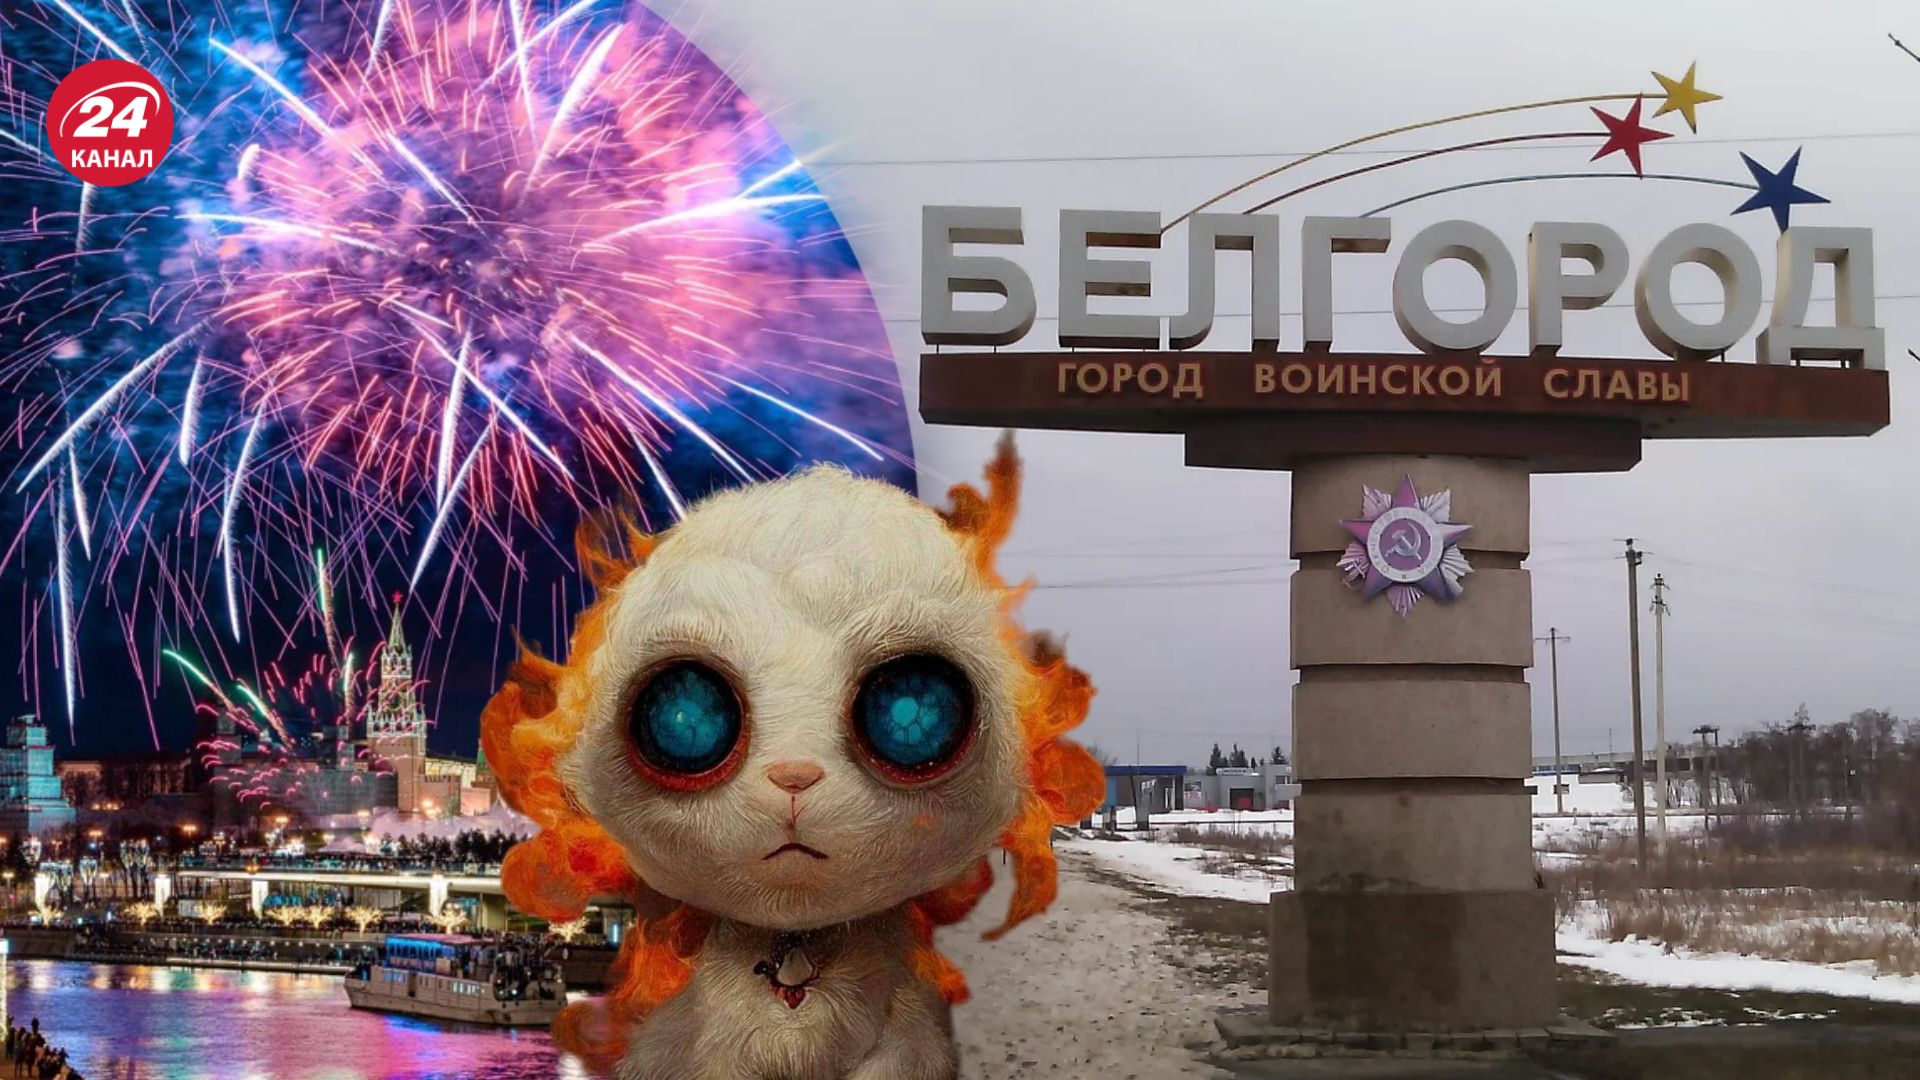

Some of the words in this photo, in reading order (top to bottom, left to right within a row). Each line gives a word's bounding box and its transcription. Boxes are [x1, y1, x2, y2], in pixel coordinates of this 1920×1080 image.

[920, 205, 1886, 370] БЕЛГОРОД
[1057, 363, 1204, 398] ГОРОД
[1255, 358, 1502, 396] ВОИНСКОЙ
[1544, 367, 1690, 402] СЛАВЫ
